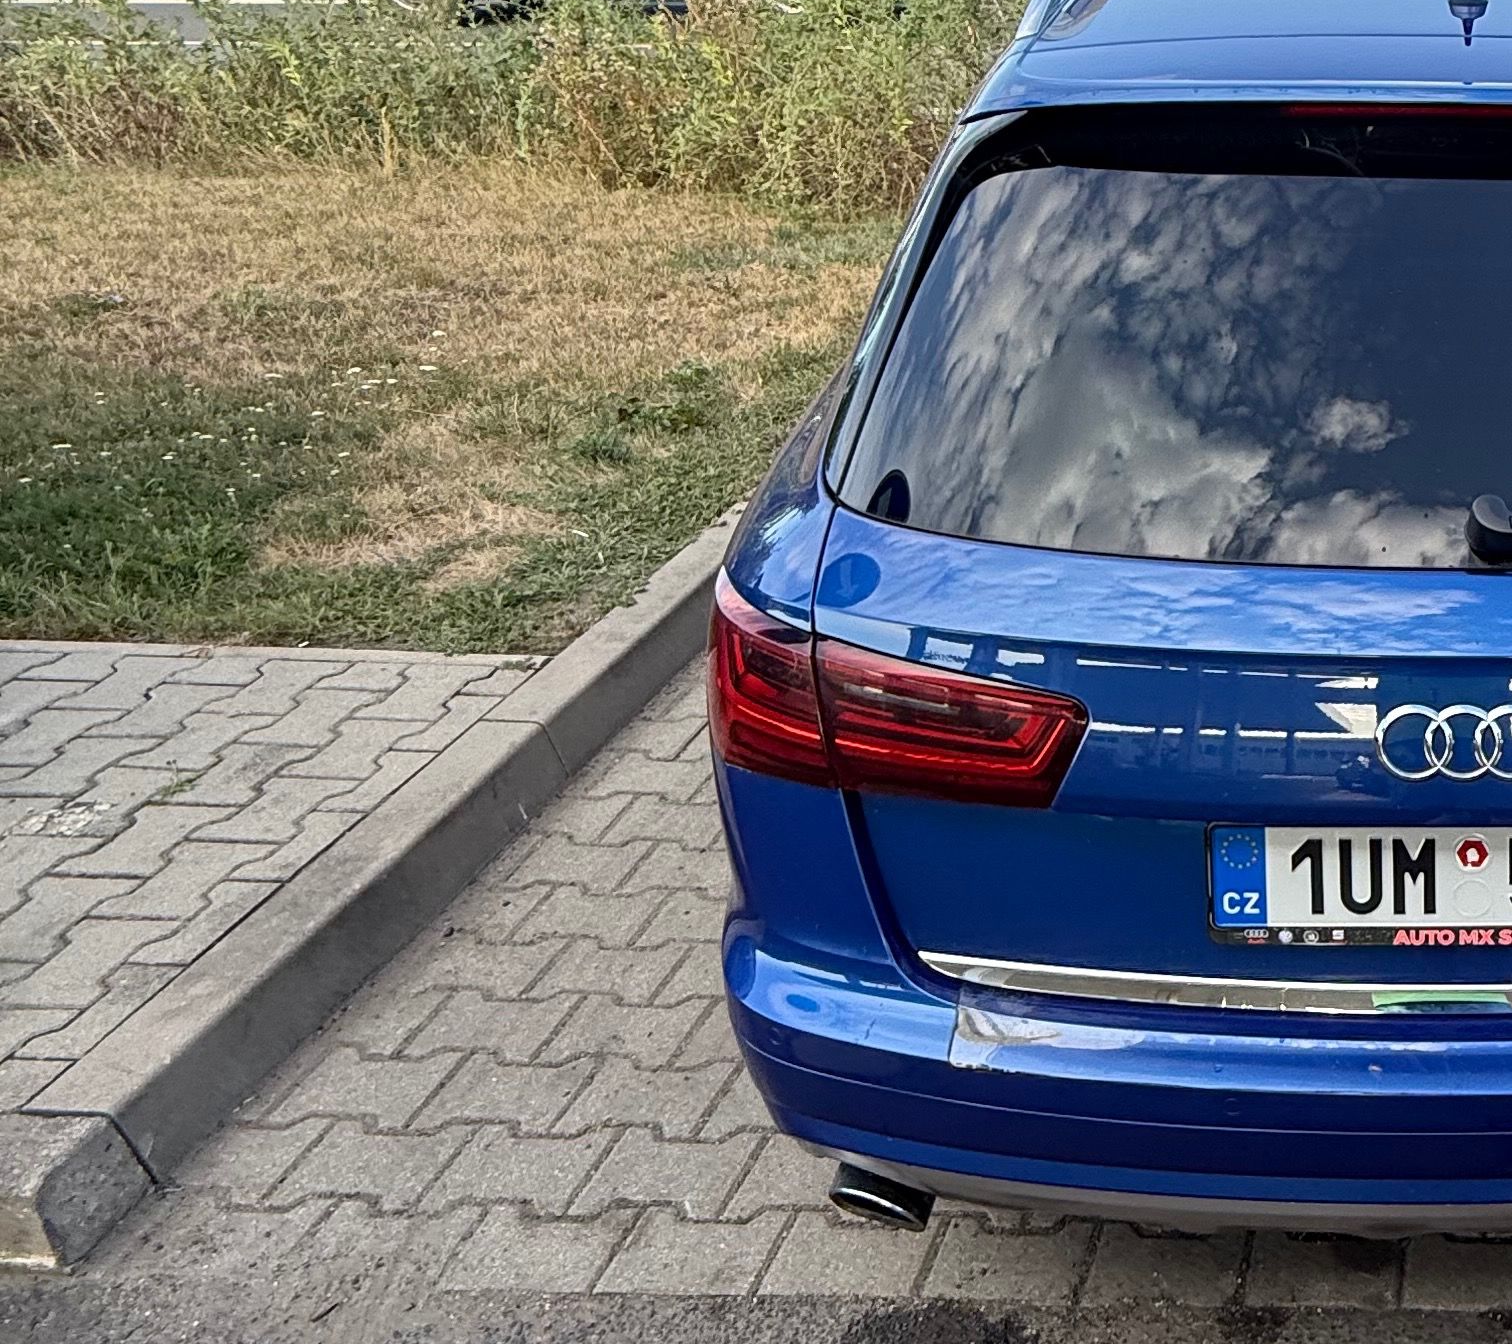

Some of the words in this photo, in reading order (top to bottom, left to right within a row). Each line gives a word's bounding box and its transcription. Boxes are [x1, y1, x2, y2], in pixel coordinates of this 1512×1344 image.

[1290, 836, 1437, 915] 1UM
[1222, 892, 1260, 914] CZ
[1393, 928, 1455, 945] AUTO
[1458, 928, 1495, 945] MX
